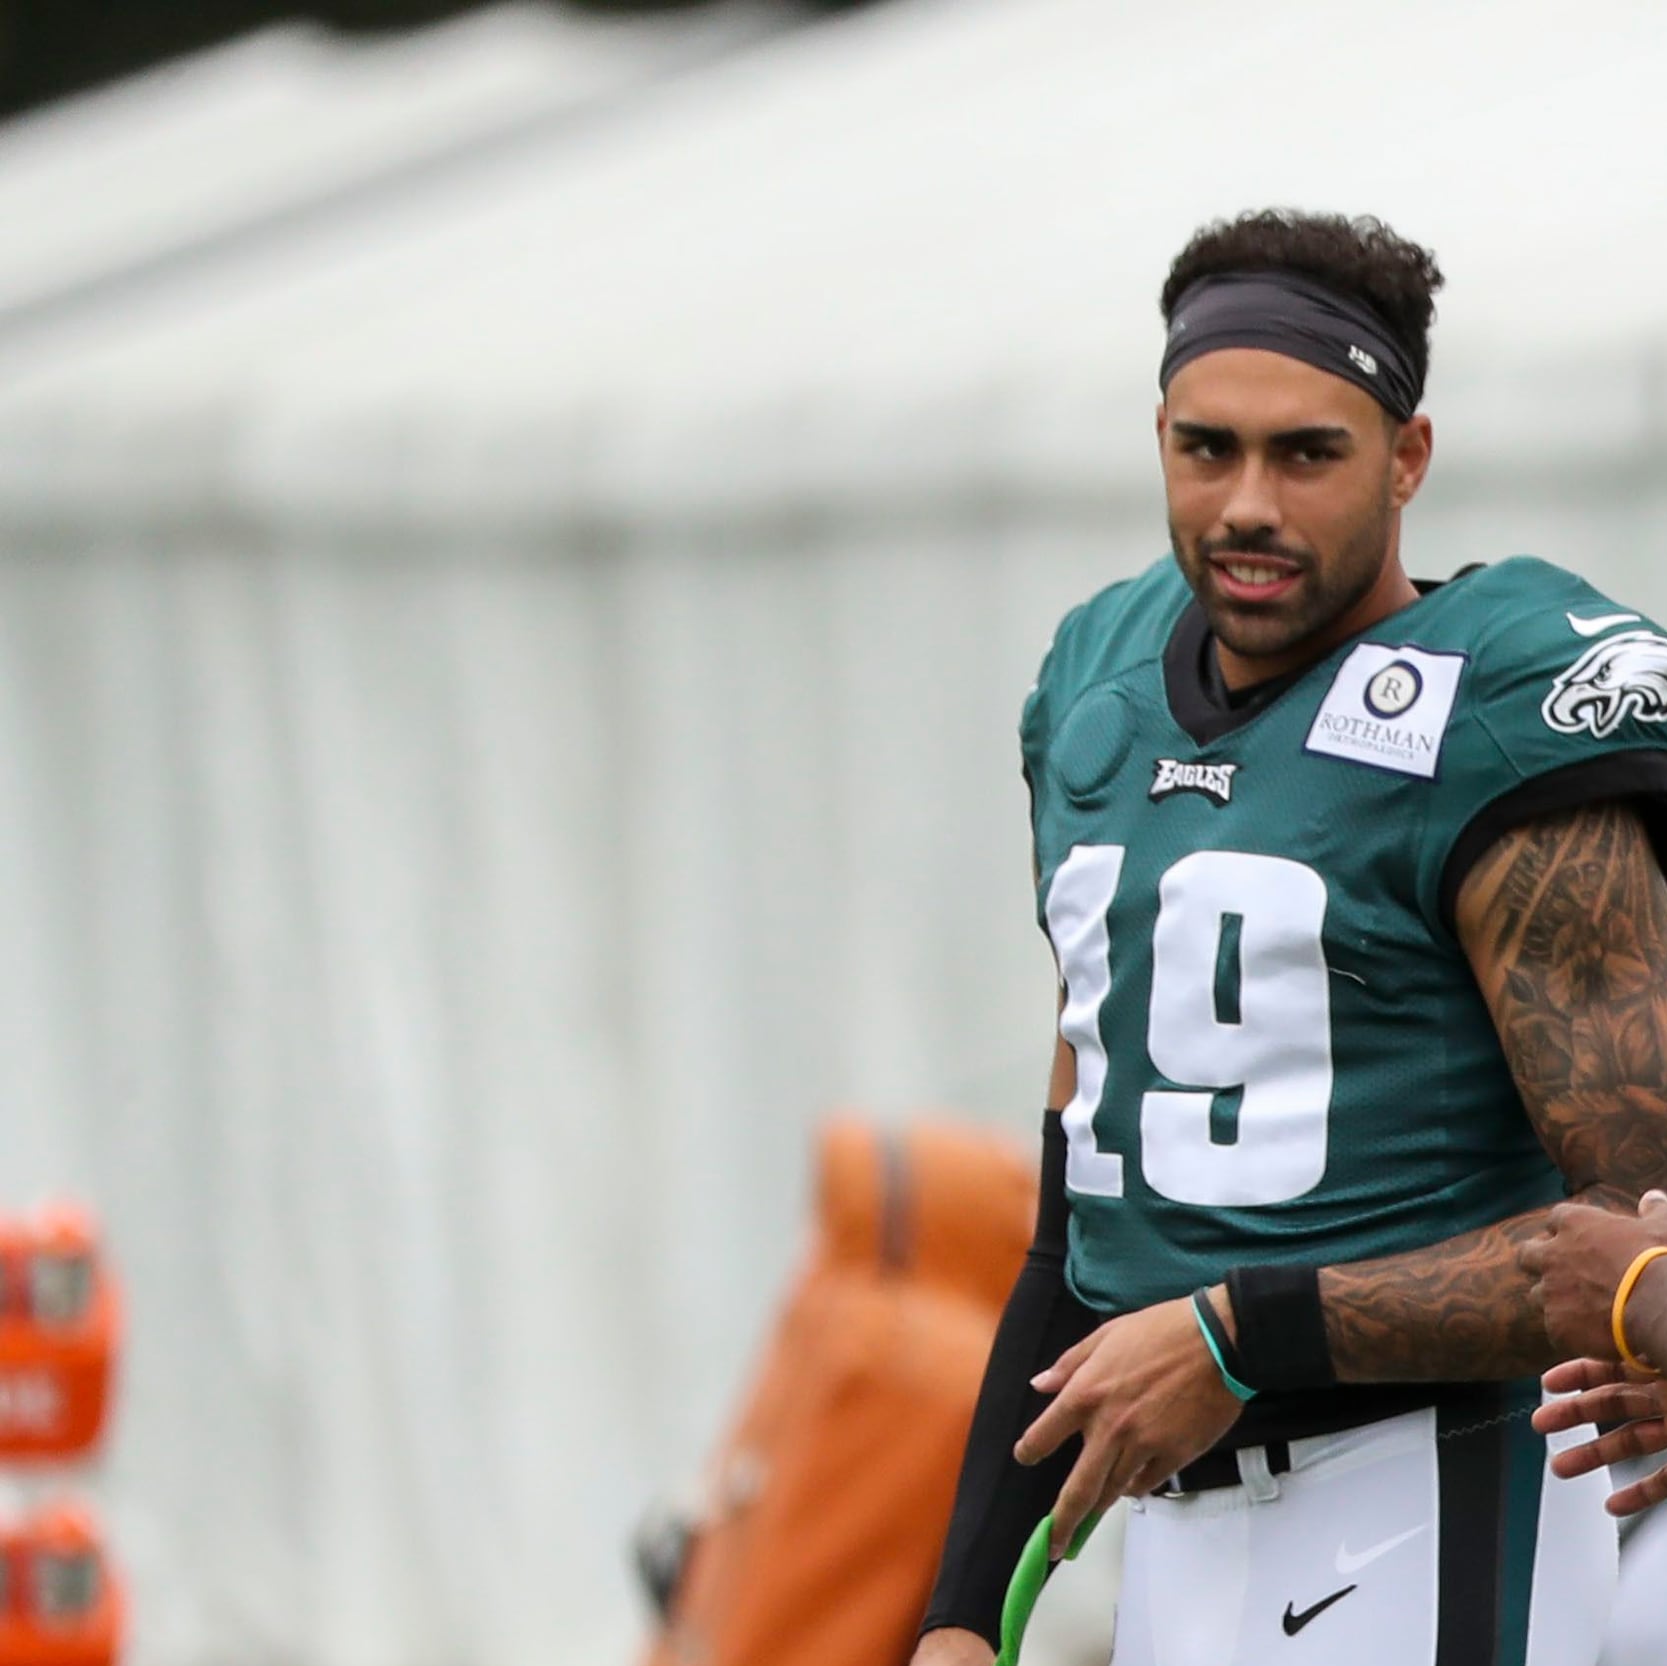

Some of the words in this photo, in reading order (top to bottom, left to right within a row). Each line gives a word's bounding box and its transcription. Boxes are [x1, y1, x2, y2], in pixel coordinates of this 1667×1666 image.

[1379, 676, 1402, 702] R
[1318, 711, 1434, 752] ROTHMAN
[1150, 759, 1237, 801] EAGLES
[1046, 845, 1333, 1207] 19
